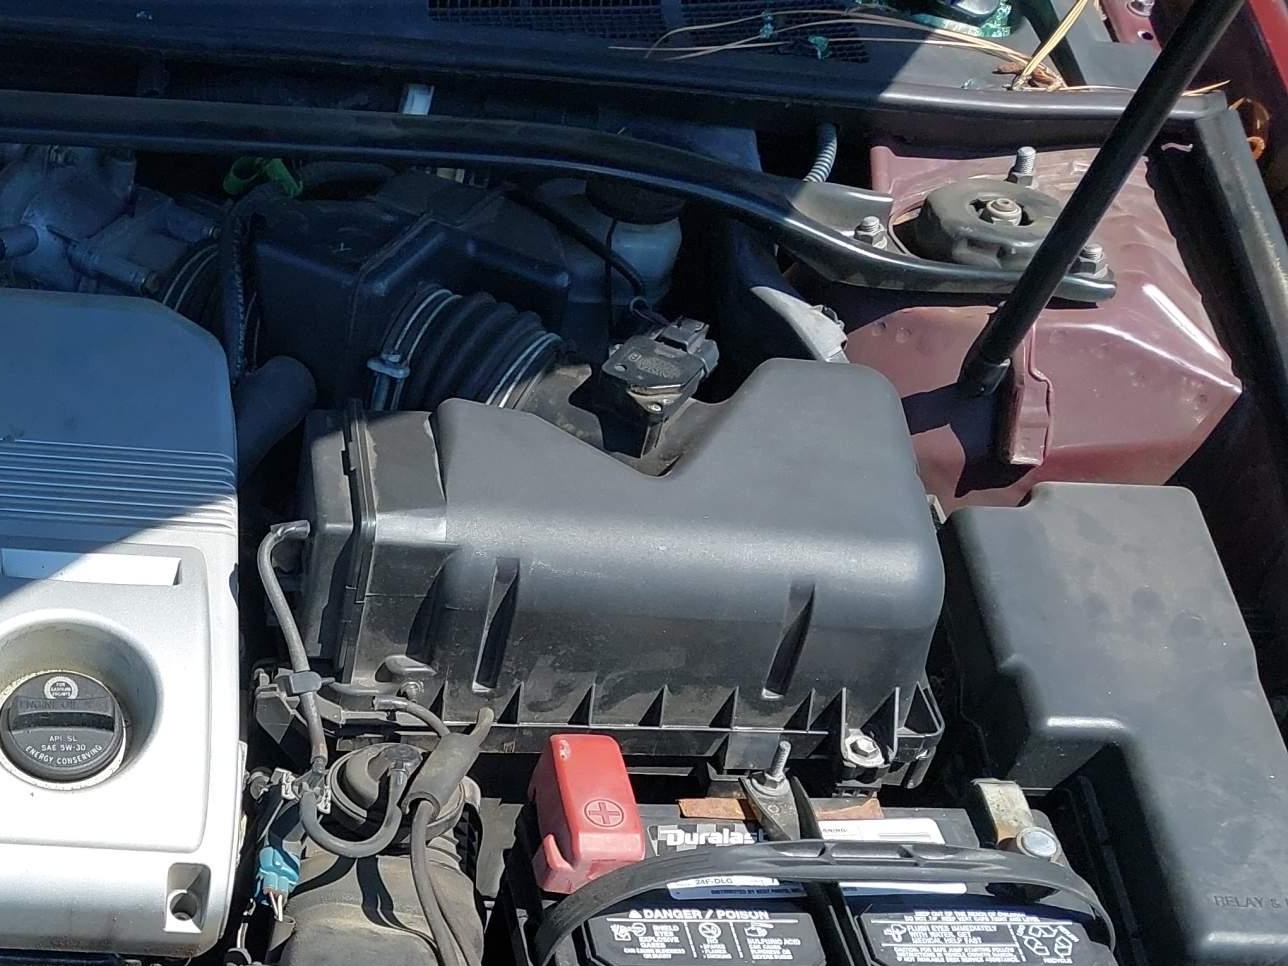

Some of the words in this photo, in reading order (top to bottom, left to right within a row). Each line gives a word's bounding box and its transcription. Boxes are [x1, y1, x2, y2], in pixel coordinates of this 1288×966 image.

[60, 744, 86, 752] 5W-30
[25, 745, 54, 763] ENERGY
[56, 744, 103, 765] CONSERVING
[1213, 895, 1264, 908] RELAY
[642, 909, 703, 919] DANGER
[714, 909, 770, 920] POISON
